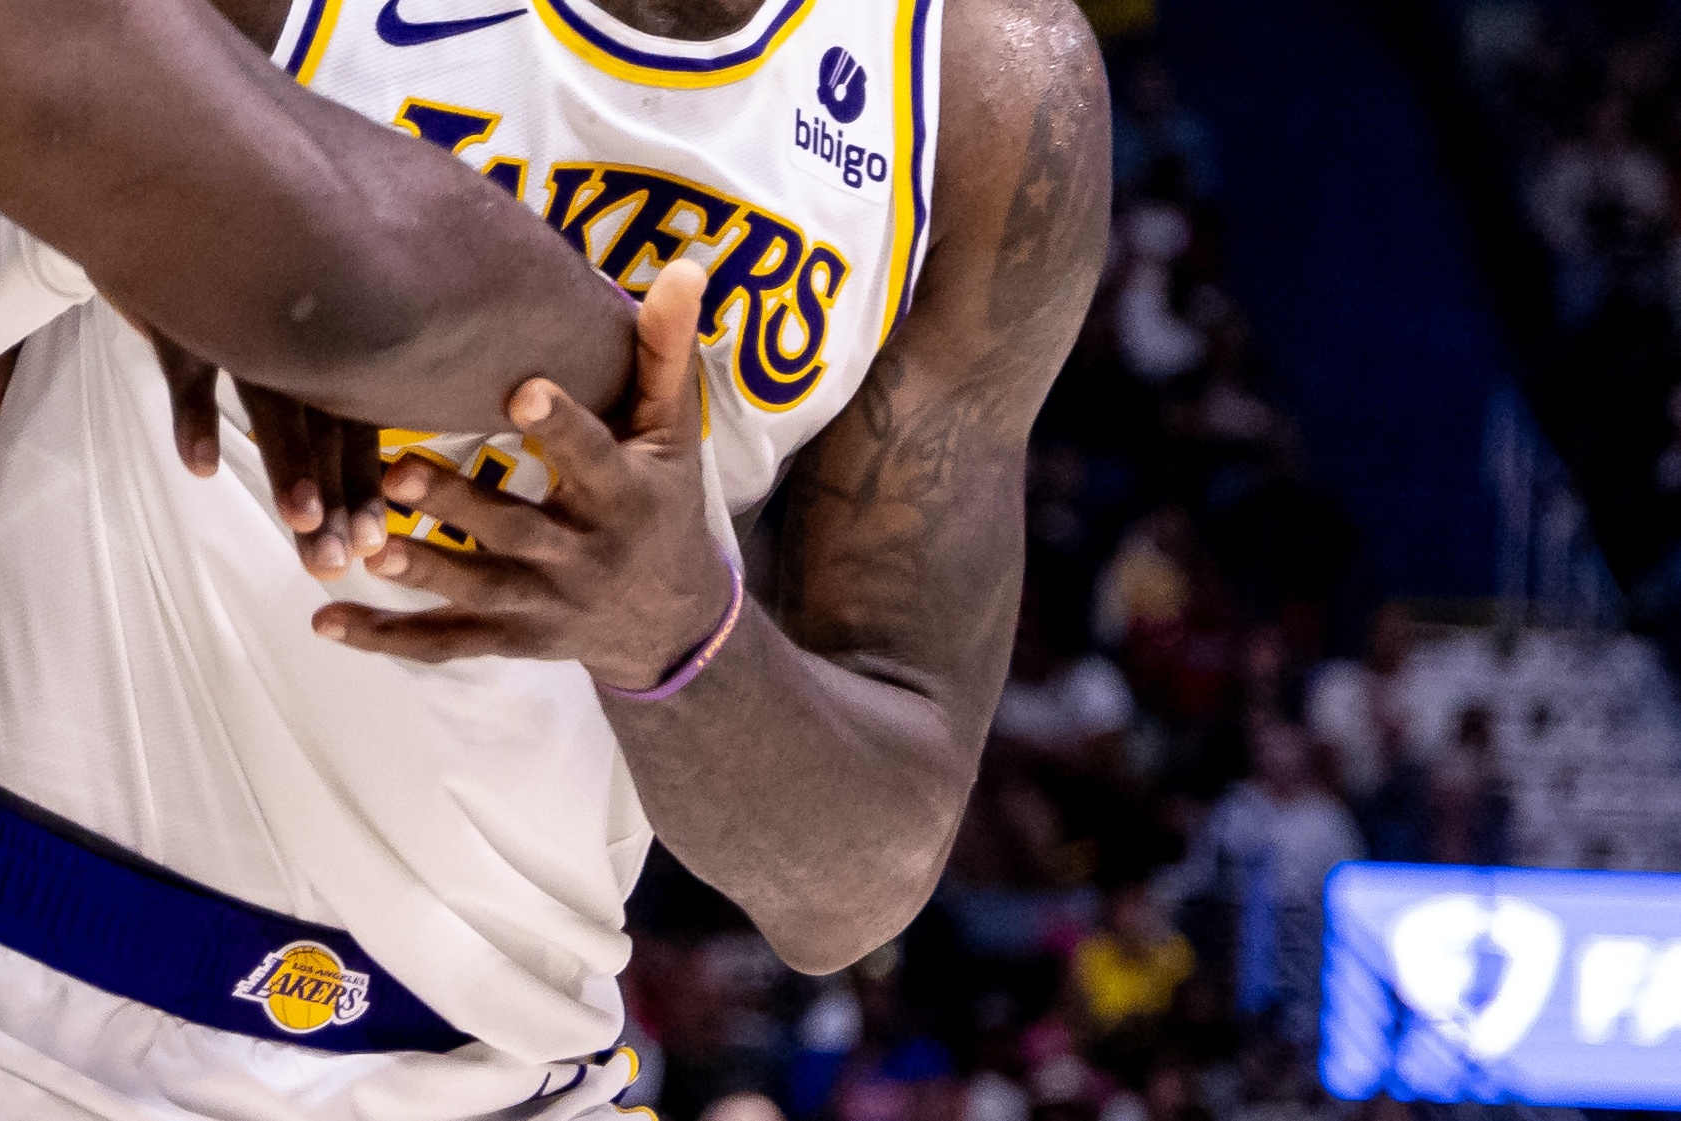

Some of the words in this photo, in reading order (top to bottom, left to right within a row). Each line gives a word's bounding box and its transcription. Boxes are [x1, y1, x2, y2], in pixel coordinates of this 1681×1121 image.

[795, 107, 888, 189] bibigo
[394, 96, 851, 413] KERS
[245, 958, 366, 1020] LAKERS
